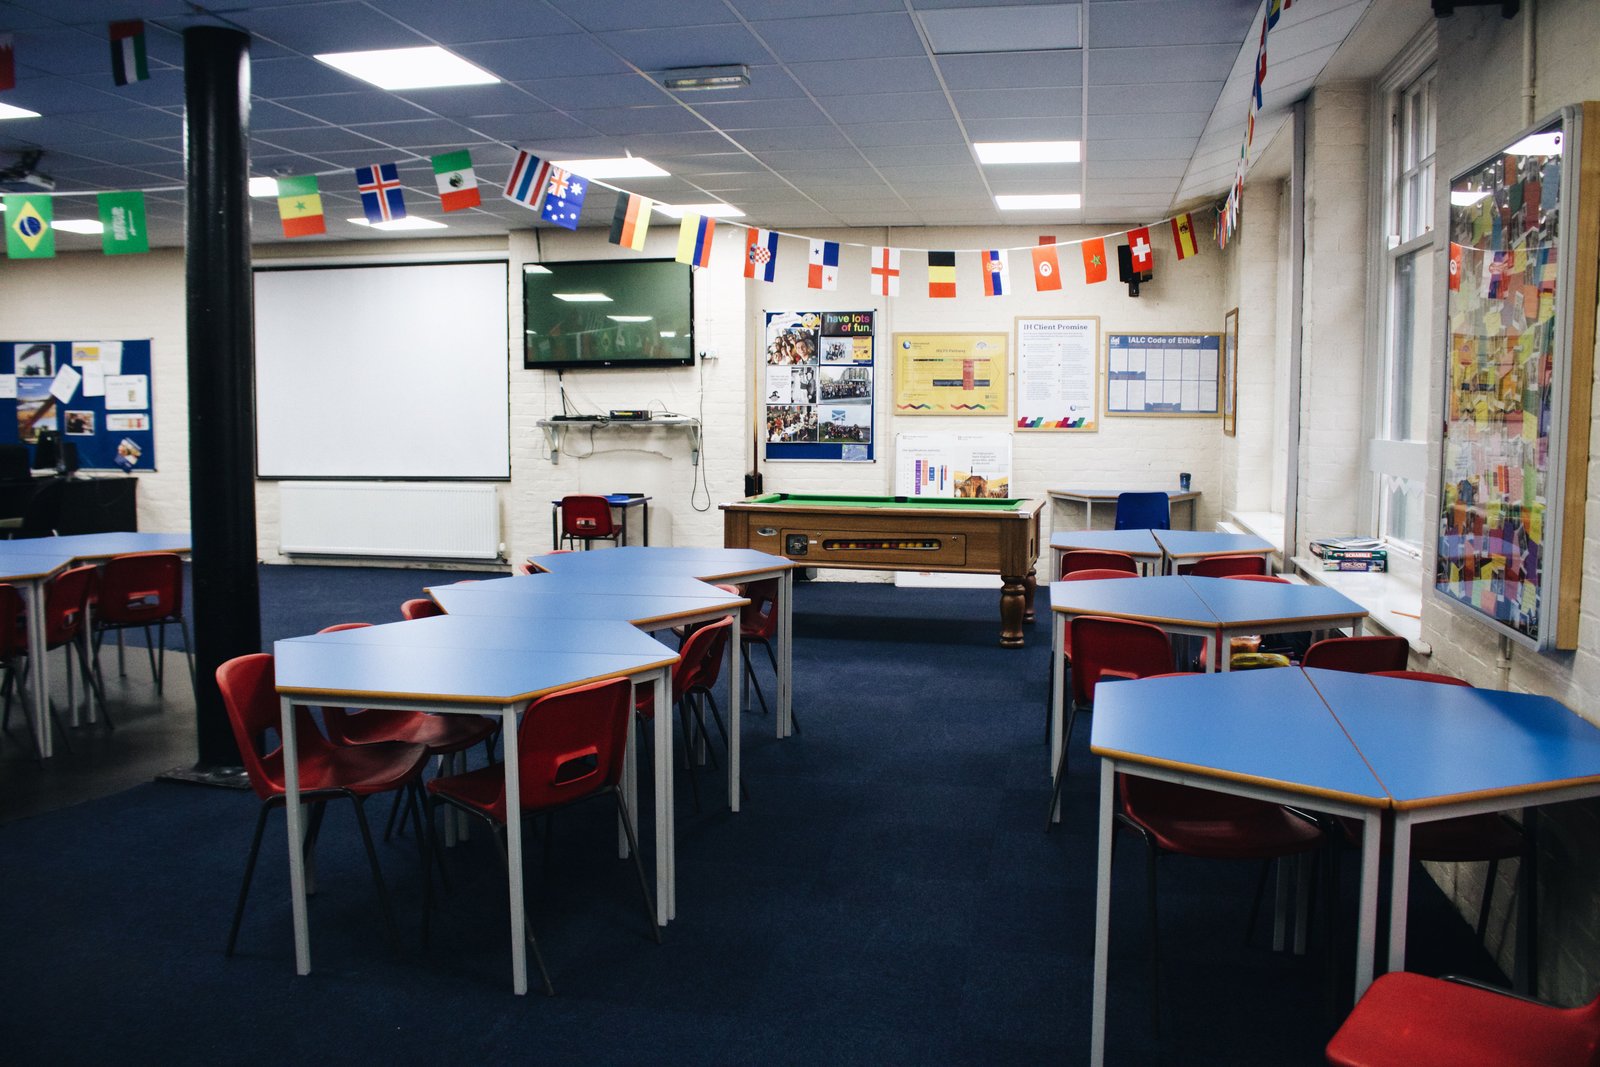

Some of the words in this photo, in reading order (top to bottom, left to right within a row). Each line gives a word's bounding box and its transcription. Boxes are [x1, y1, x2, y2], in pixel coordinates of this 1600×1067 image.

[826, 313, 850, 323] have
[852, 313, 870, 323] lots
[841, 323, 852, 332] of
[853, 323, 872, 332] fun.
[1128, 336, 1146, 344] IALC
[1147, 336, 1167, 344] Code
[1168, 336, 1177, 344] of
[1177, 336, 1201, 344] Ethics
